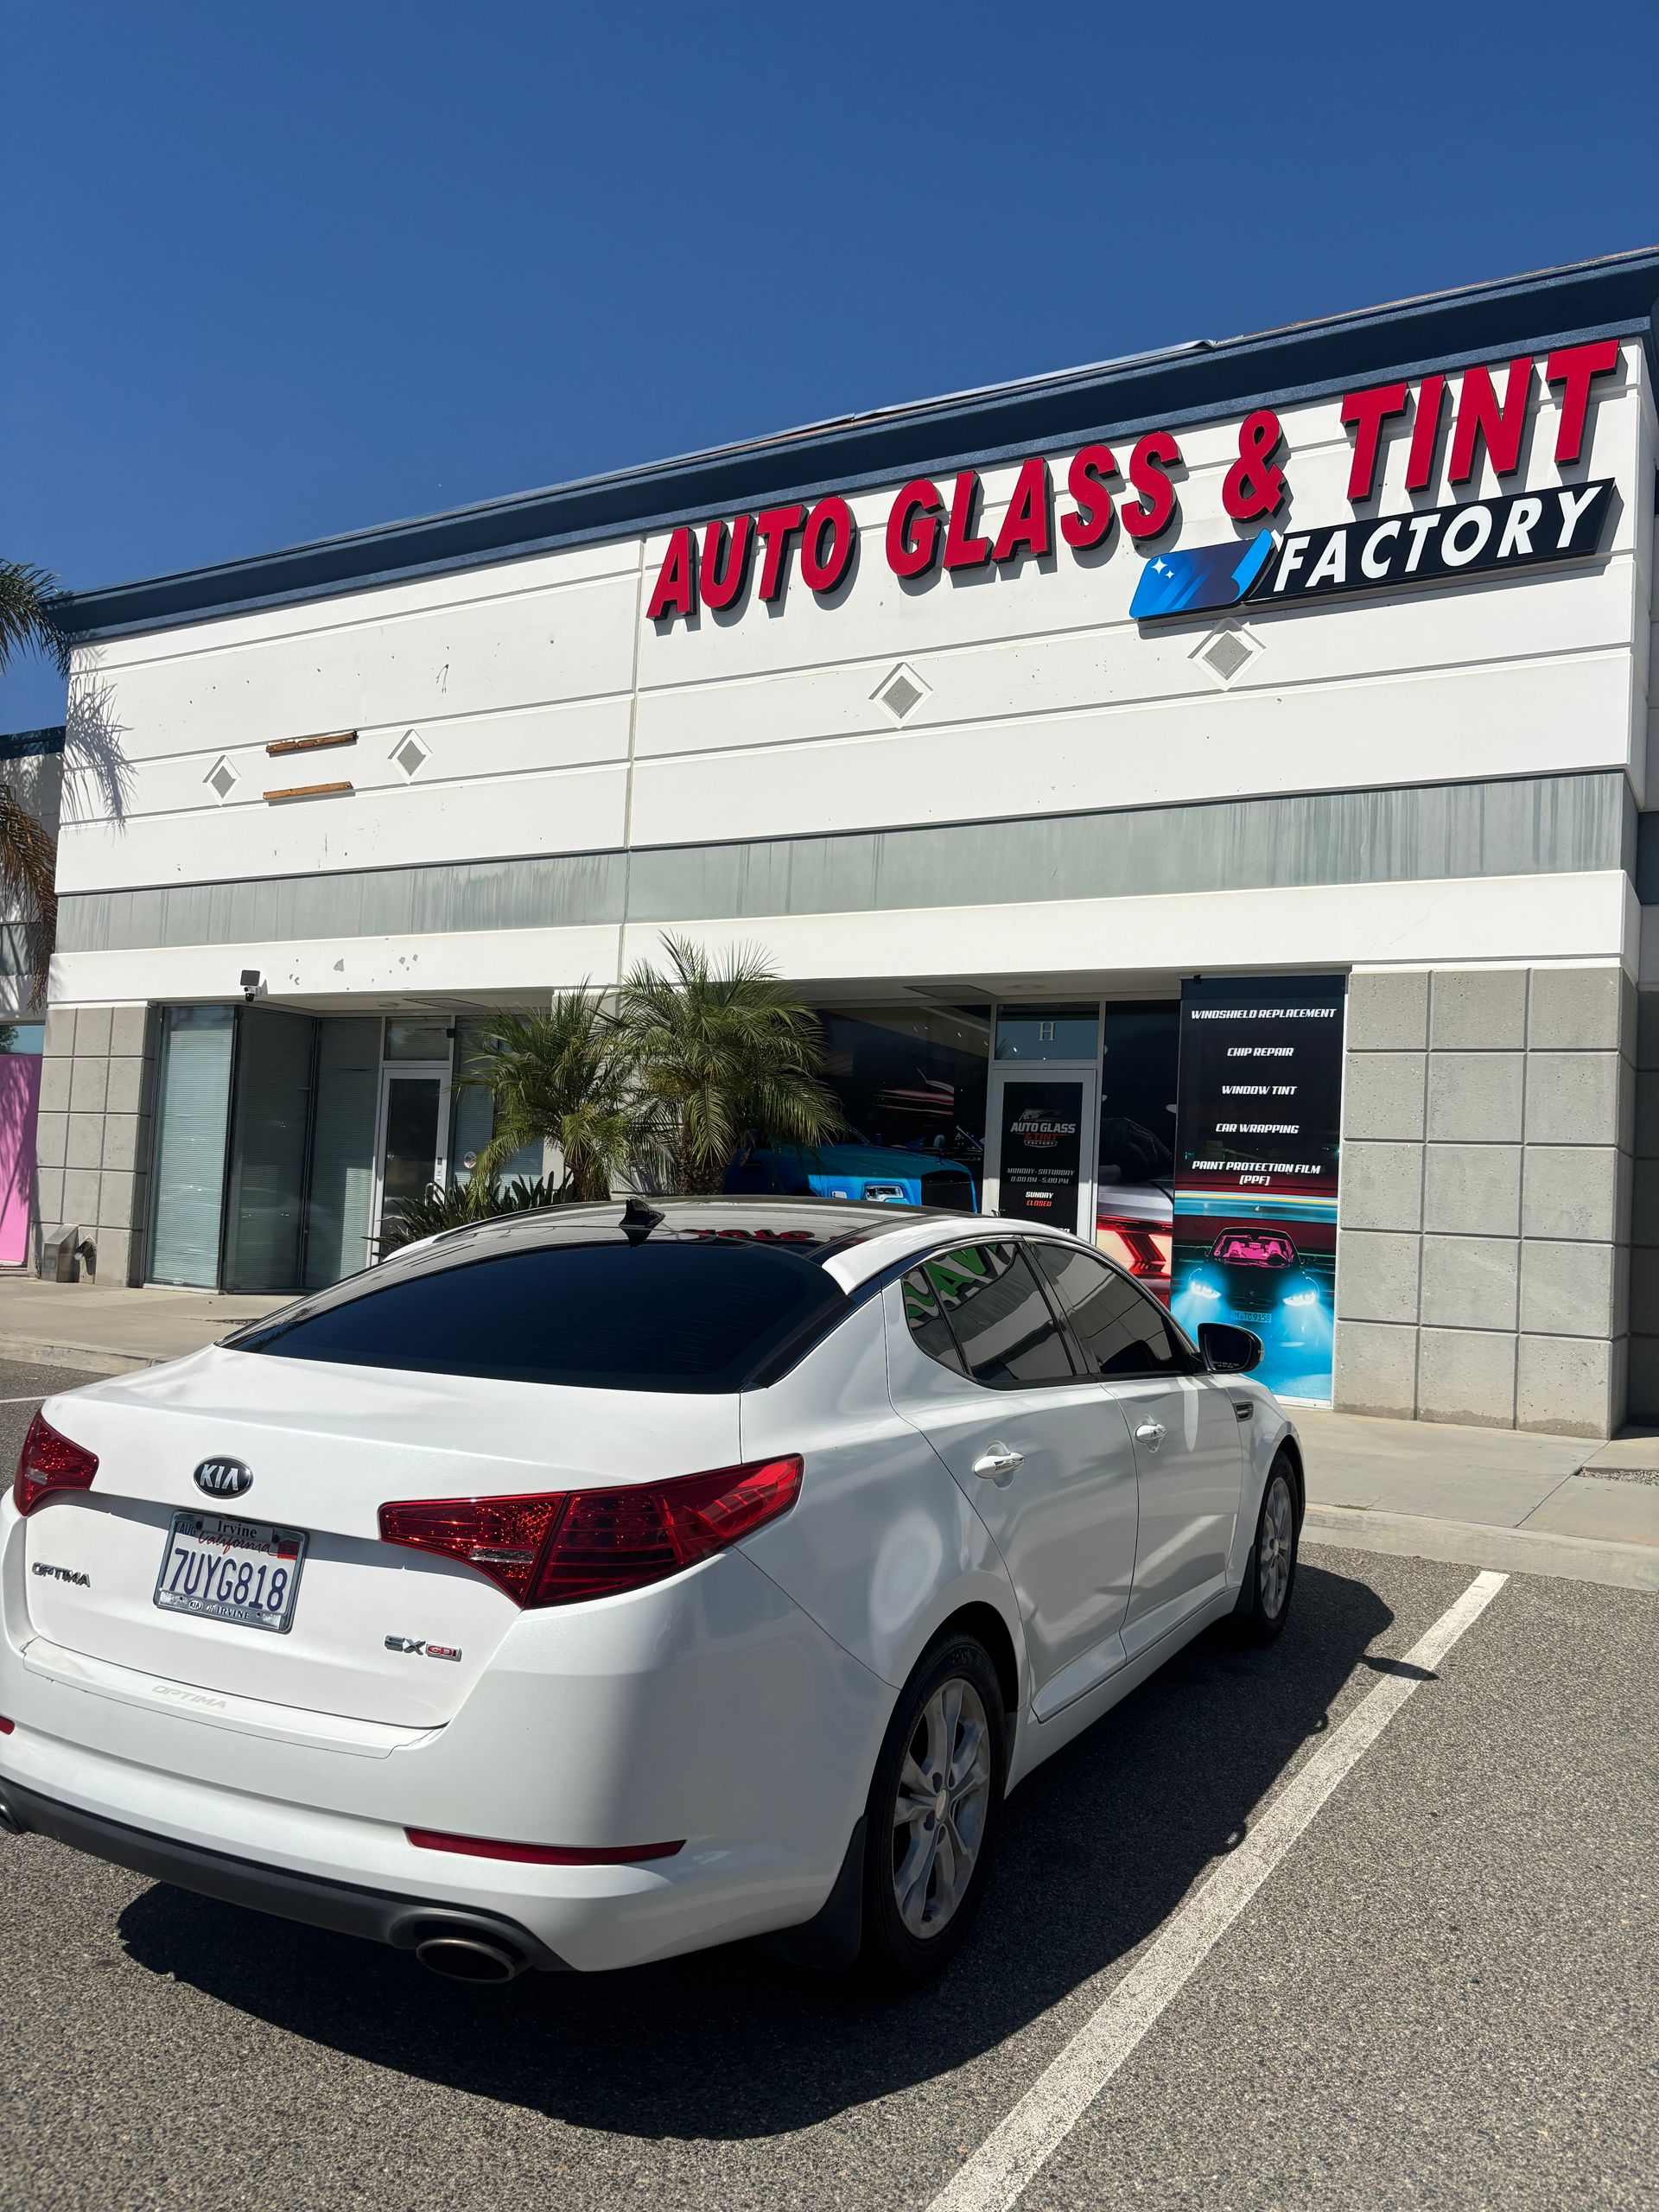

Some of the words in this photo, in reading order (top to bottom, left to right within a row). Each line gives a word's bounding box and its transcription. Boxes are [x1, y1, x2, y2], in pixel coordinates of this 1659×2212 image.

[646, 495, 854, 620] AUTO
[886, 431, 1182, 580] GLASS
[1222, 410, 1286, 523] &
[1340, 340, 1619, 504] TINT
[1273, 486, 1602, 593] FACTORY
[1191, 1009, 1258, 1020] WINDSHIELD
[1258, 1008, 1337, 1019] REPLACEMENT
[1038, 1022, 1056, 1041] H
[1227, 1047, 1253, 1057] CHIP
[1253, 1047, 1294, 1057] REPAIR
[1222, 1085, 1270, 1096] WINDOW
[1272, 1085, 1298, 1096] TINT
[1010, 1122, 1039, 1133] AUTO
[1039, 1122, 1076, 1135] GLASS
[1216, 1123, 1237, 1133] CAR
[1239, 1123, 1300, 1135] WRAPPING
[1192, 1160, 1225, 1170] PAINT
[1225, 1161, 1294, 1173] PROTECTION
[1294, 1164, 1321, 1174] FILM
[200, 1464, 238, 1491] KIA
[179, 1522, 196, 1536] AUG
[217, 1520, 257, 1538] Irvine
[198, 1530, 271, 1556] California
[32, 1562, 91, 1588] OPTIMA
[169, 1548, 288, 1611] 7UYG818
[217, 1607, 251, 1620] IRVINE
[385, 1635, 426, 1656] EX
[152, 1685, 226, 1708] OPTIMA
